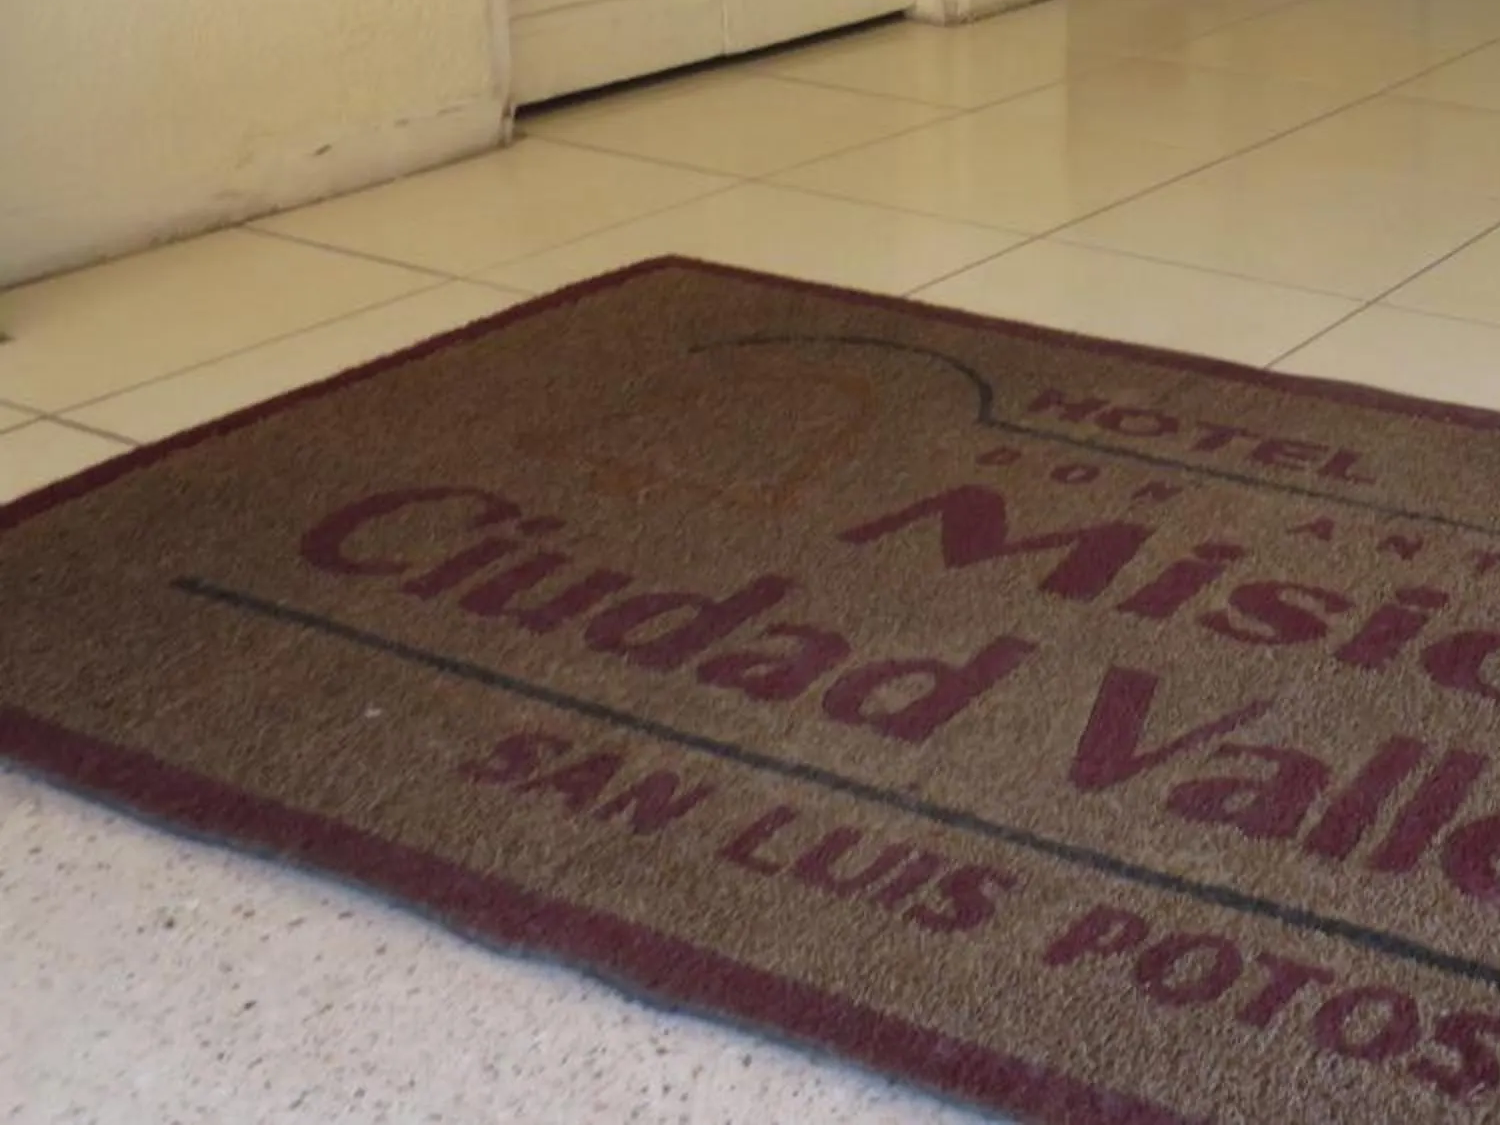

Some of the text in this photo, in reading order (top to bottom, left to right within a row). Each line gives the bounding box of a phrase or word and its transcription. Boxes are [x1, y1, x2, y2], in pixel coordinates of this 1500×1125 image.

[976, 446, 1183, 503] DON
[1026, 388, 1376, 485] HOTEL
[299, 486, 1036, 744] Ciudad
[457, 730, 715, 835] SAN
[714, 805, 1024, 934] LUIS
